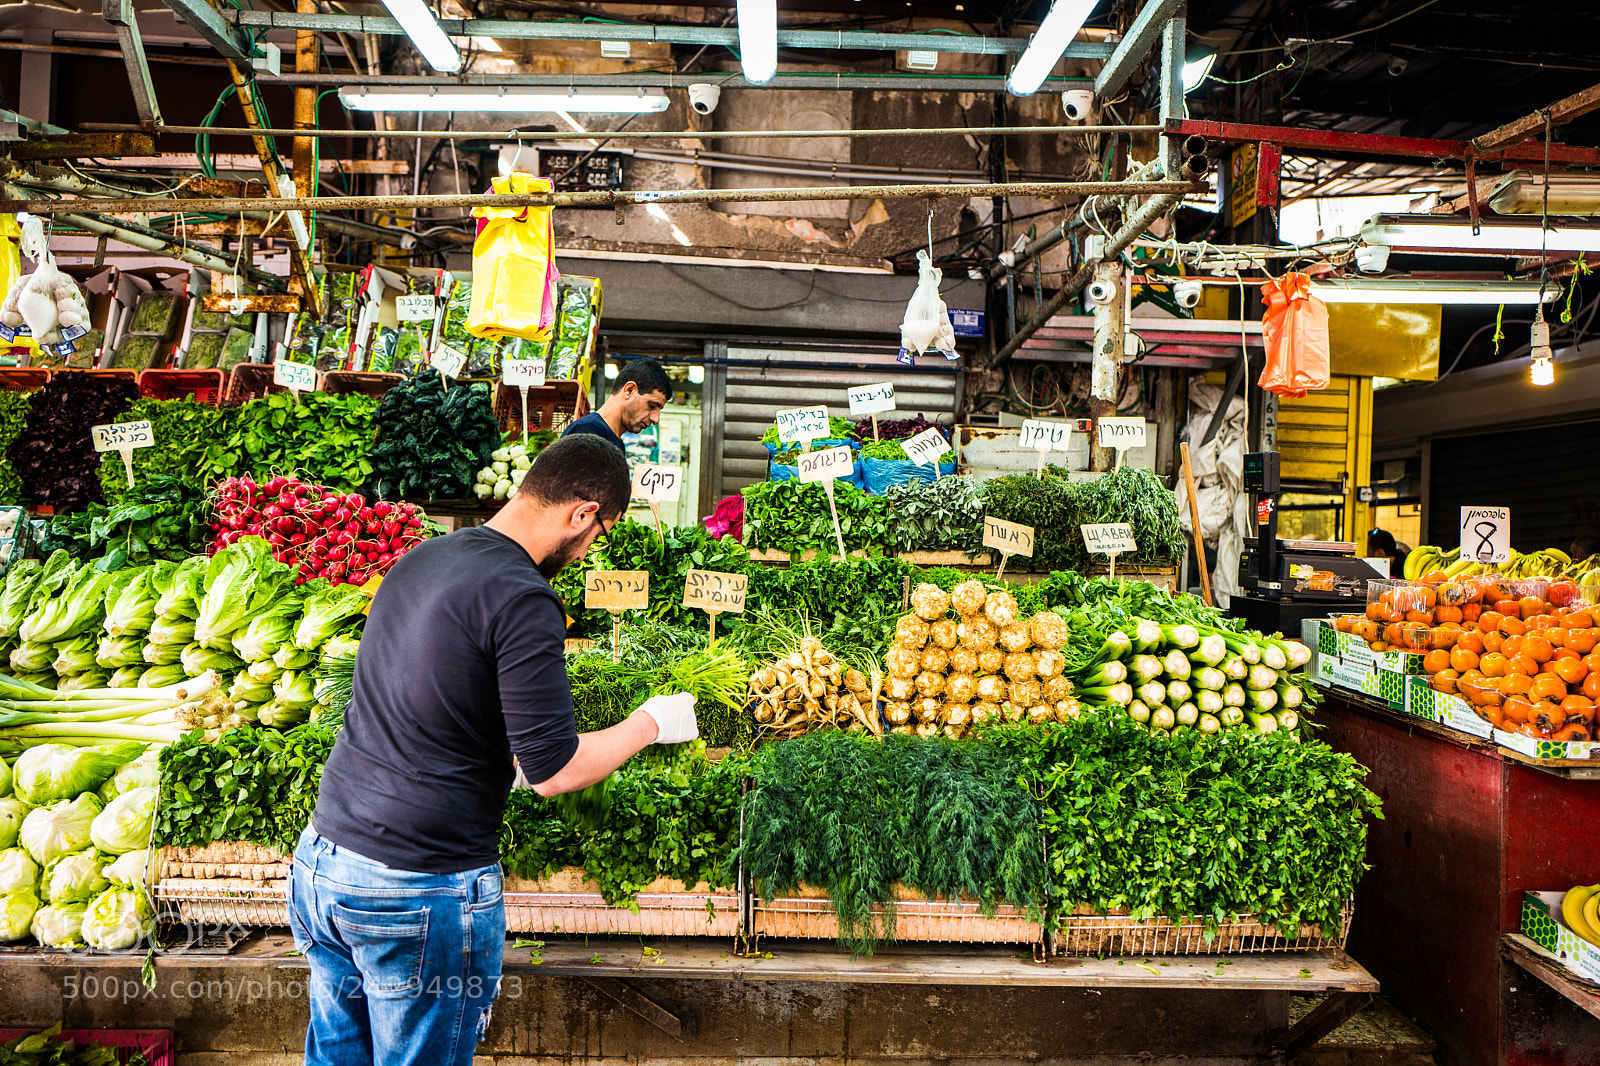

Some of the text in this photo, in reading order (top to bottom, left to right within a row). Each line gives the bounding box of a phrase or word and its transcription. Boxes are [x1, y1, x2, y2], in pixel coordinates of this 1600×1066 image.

[1024, 425, 1064, 446] טימין
[1098, 424, 1144, 444] רוזמרין
[1474, 521, 1498, 561] 8
[587, 578, 645, 593] עירית
[687, 572, 745, 592] עירית
[688, 588, 743, 604] שומית
